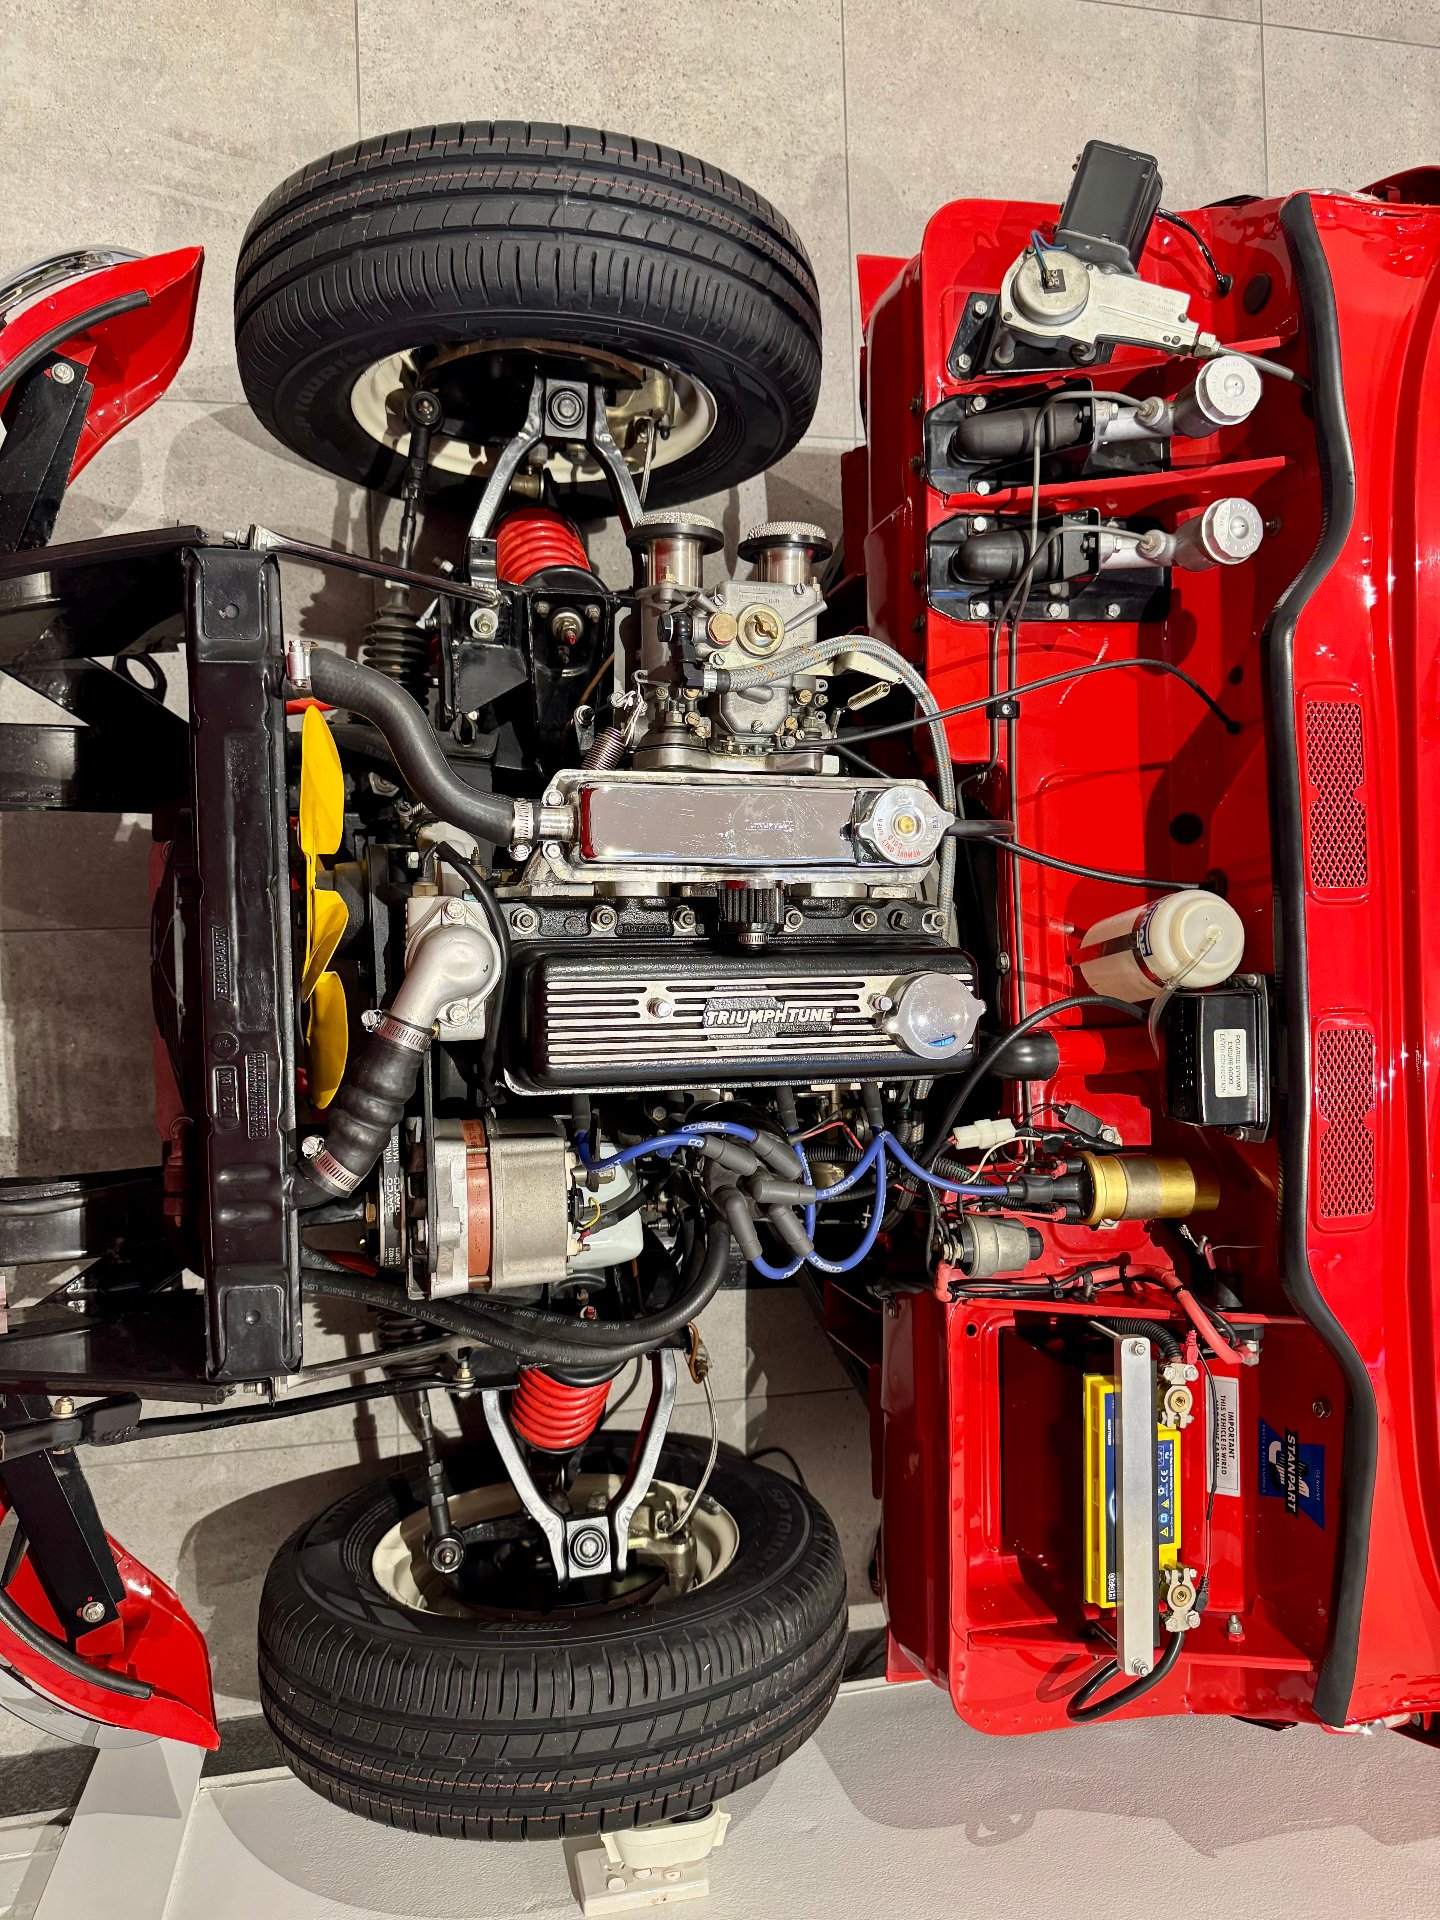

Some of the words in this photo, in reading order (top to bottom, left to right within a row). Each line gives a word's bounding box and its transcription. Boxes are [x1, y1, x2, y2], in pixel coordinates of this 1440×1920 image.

[887, 834, 903, 850] COLD
[896, 849, 921, 858] REMOVE
[215, 932, 228, 993] STANPART
[705, 1001, 834, 1033] TRIUMPHTUNE
[682, 1121, 728, 1132] COBALT
[821, 1175, 855, 1197] COBALT
[810, 1255, 843, 1273] COBALT
[1287, 1434, 1296, 1512] STANPART
